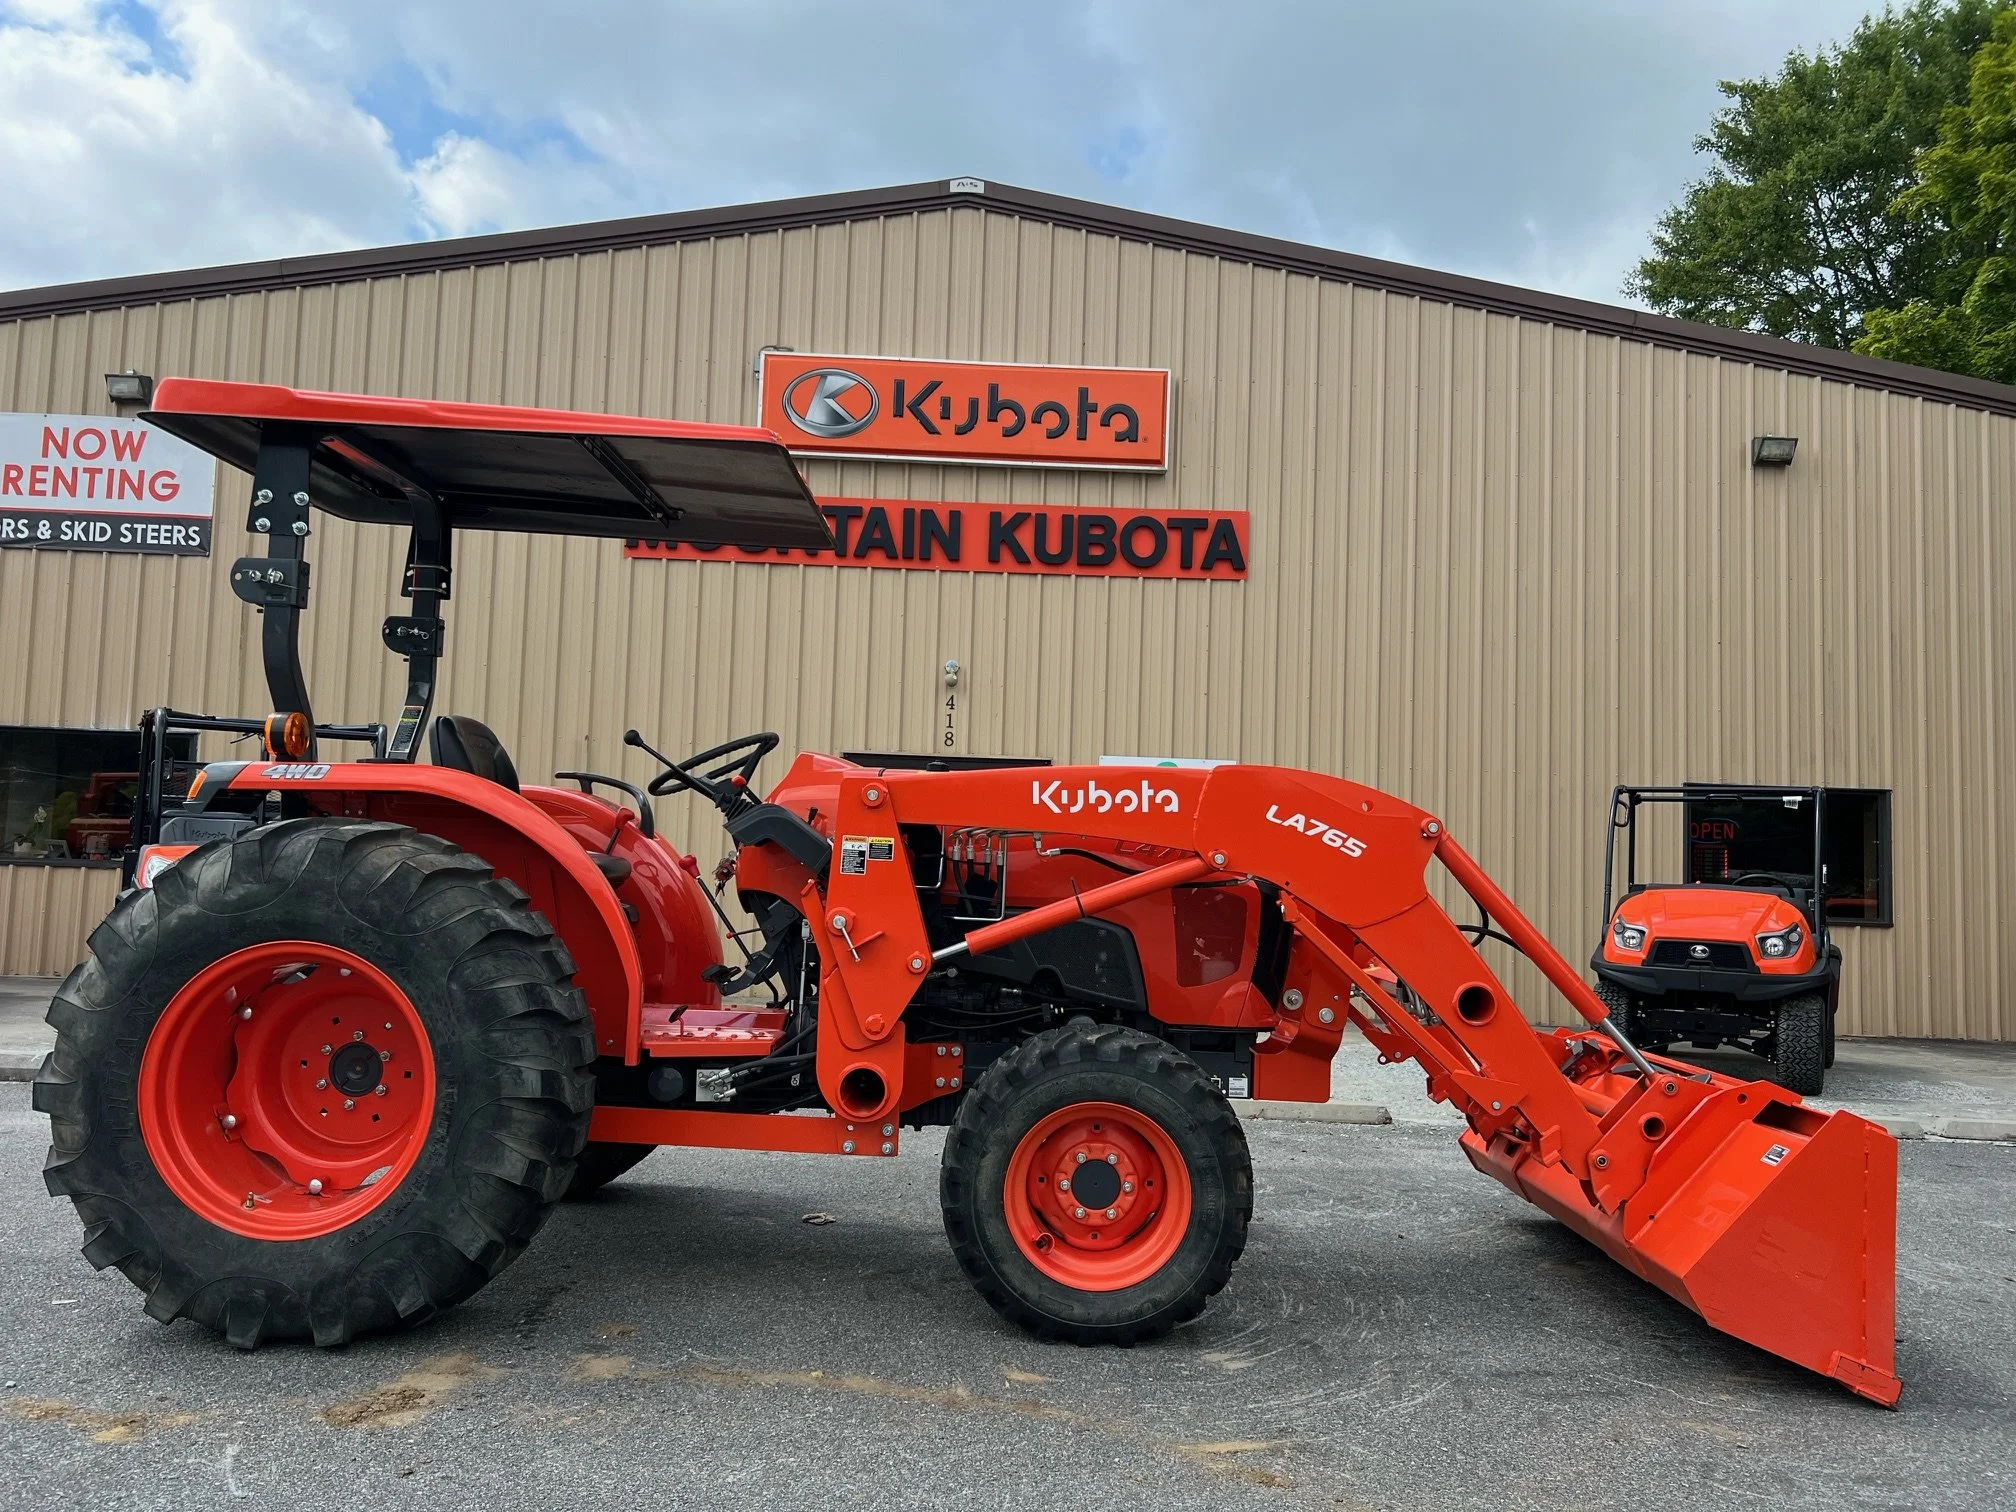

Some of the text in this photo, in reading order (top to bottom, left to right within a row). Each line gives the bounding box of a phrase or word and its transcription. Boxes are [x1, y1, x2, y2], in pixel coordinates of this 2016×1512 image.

[893, 379, 1139, 443] Kubota
[41, 426, 147, 462] NOW
[1, 464, 181, 502] RENTING
[0, 518, 201, 547] RS & SKID STEERS
[988, 511, 1247, 571] KUBOTA
[944, 694, 956, 747] 418
[261, 763, 333, 780] 4WD
[1031, 779, 1180, 814] Kubota
[1265, 804, 1367, 858] LA765
[1690, 822, 1734, 839] OPEN
